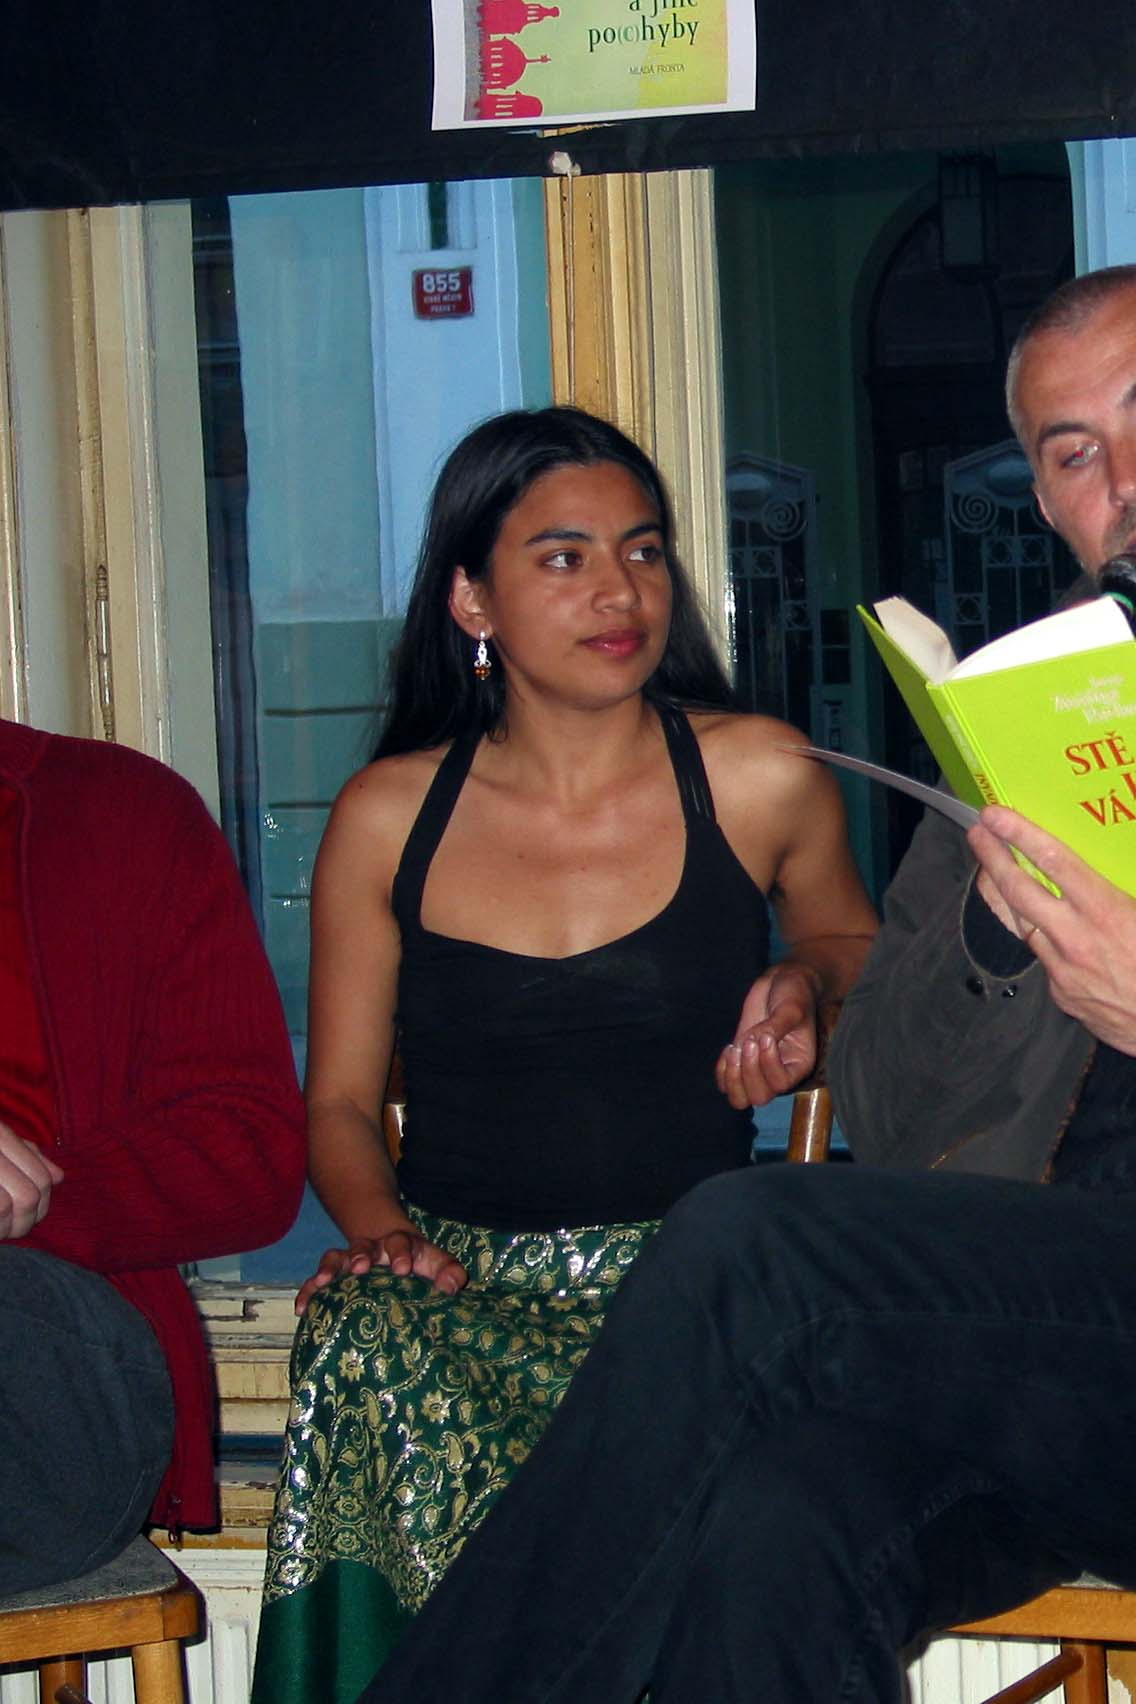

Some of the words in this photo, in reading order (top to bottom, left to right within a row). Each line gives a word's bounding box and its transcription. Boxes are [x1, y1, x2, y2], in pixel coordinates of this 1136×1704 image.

[588, 12, 699, 52] po(c)hyby
[422, 272, 460, 293] 855
[1065, 731, 1135, 776] STĚ
